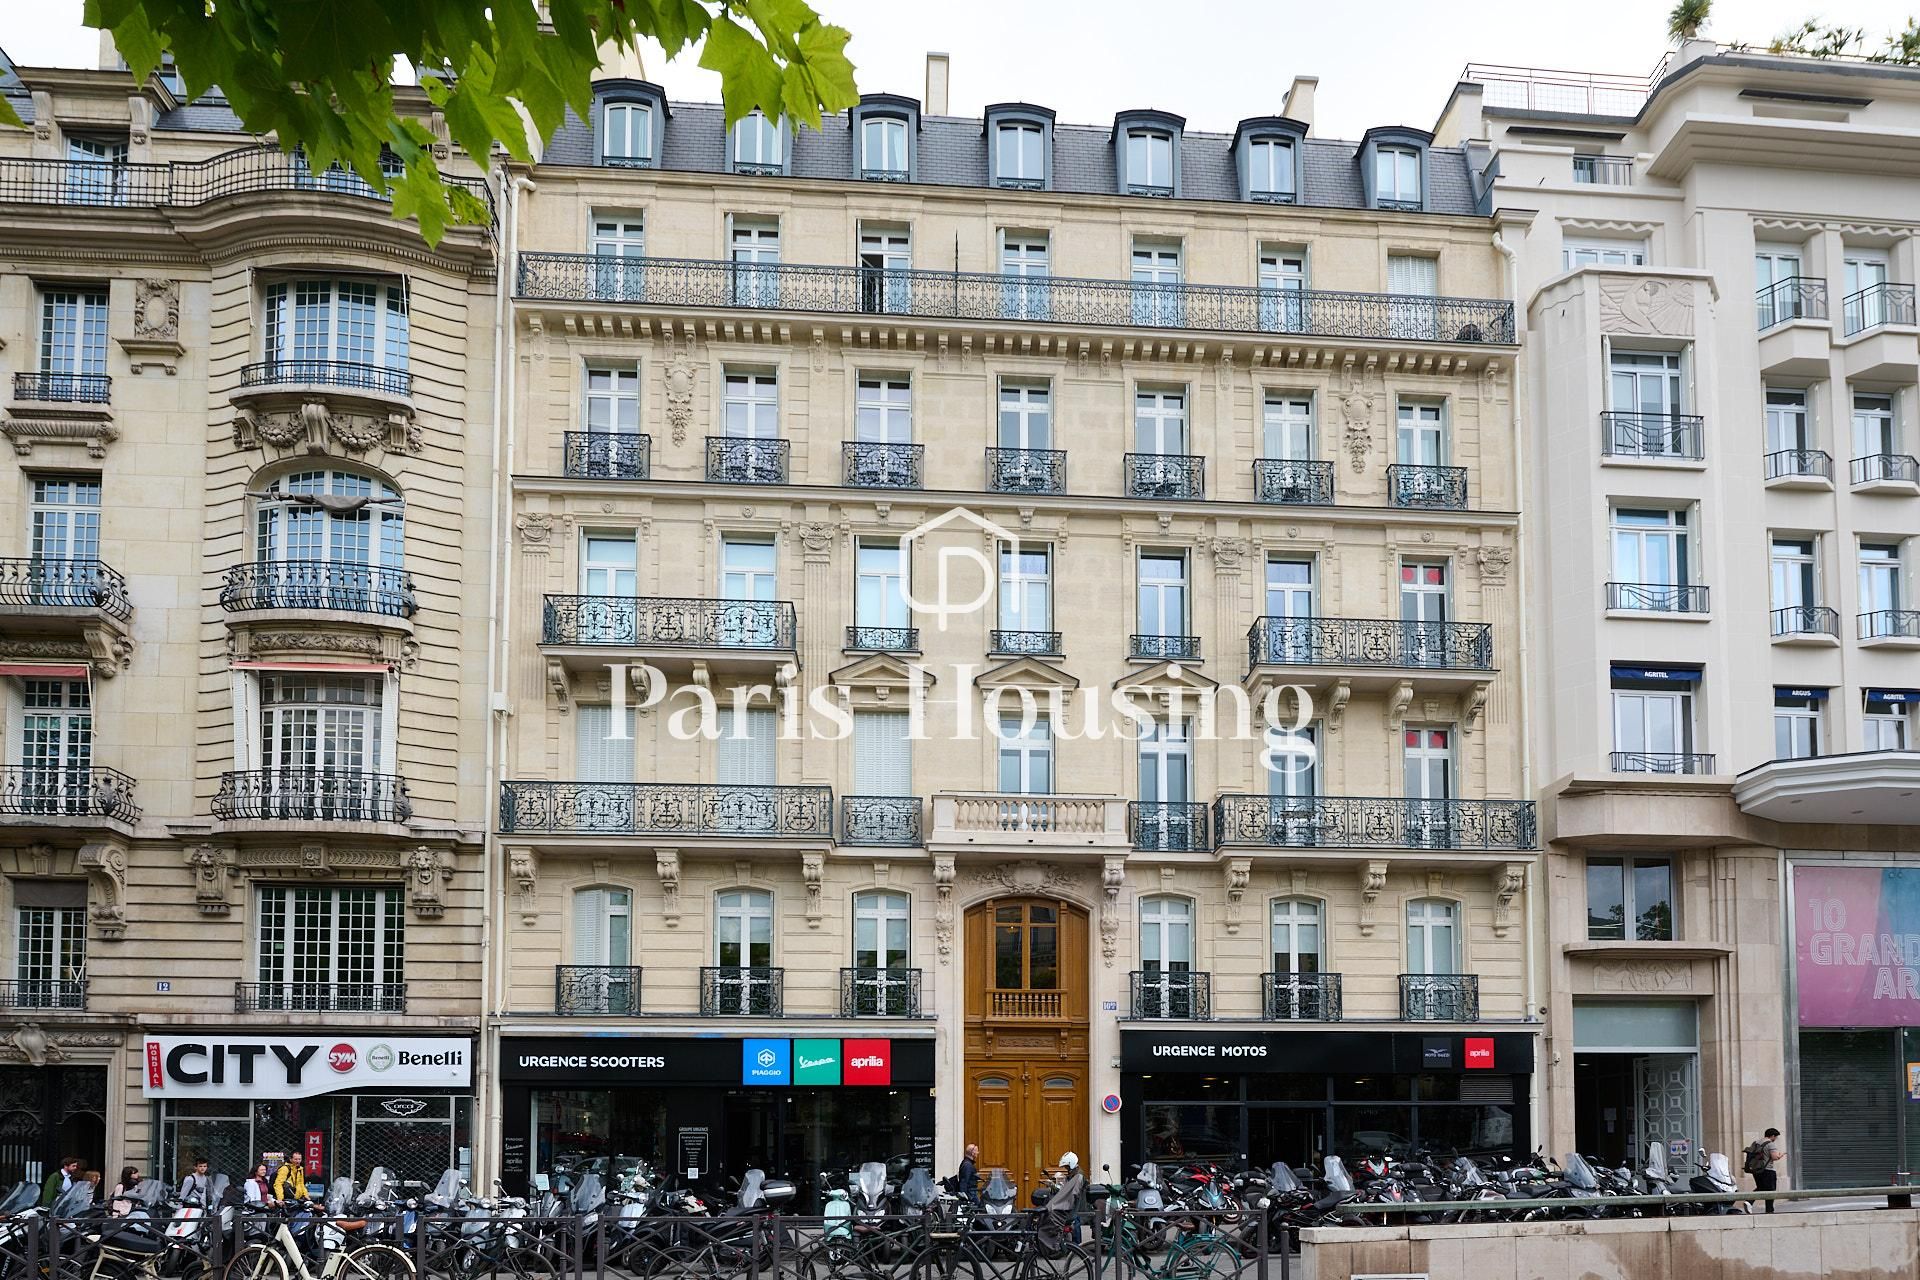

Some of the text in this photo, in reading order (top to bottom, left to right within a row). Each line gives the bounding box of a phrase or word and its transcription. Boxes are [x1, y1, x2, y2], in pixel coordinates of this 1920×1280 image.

[1808, 899, 1847, 932] 10
[158, 982, 169, 991] 12
[1152, 1045, 1267, 1057] URGENCE MOTOS
[1469, 1049, 1490, 1057] aprilia
[149, 1044, 160, 1084] MONDIAL
[166, 1043, 320, 1084] CITY
[329, 1052, 356, 1065] SYM
[398, 1051, 462, 1065] Benelli
[519, 1056, 665, 1068] URGENCE SCOOTERS
[799, 1056, 835, 1068] Vespa
[851, 1056, 883, 1068] aprilia
[309, 1135, 320, 1170] MCT
